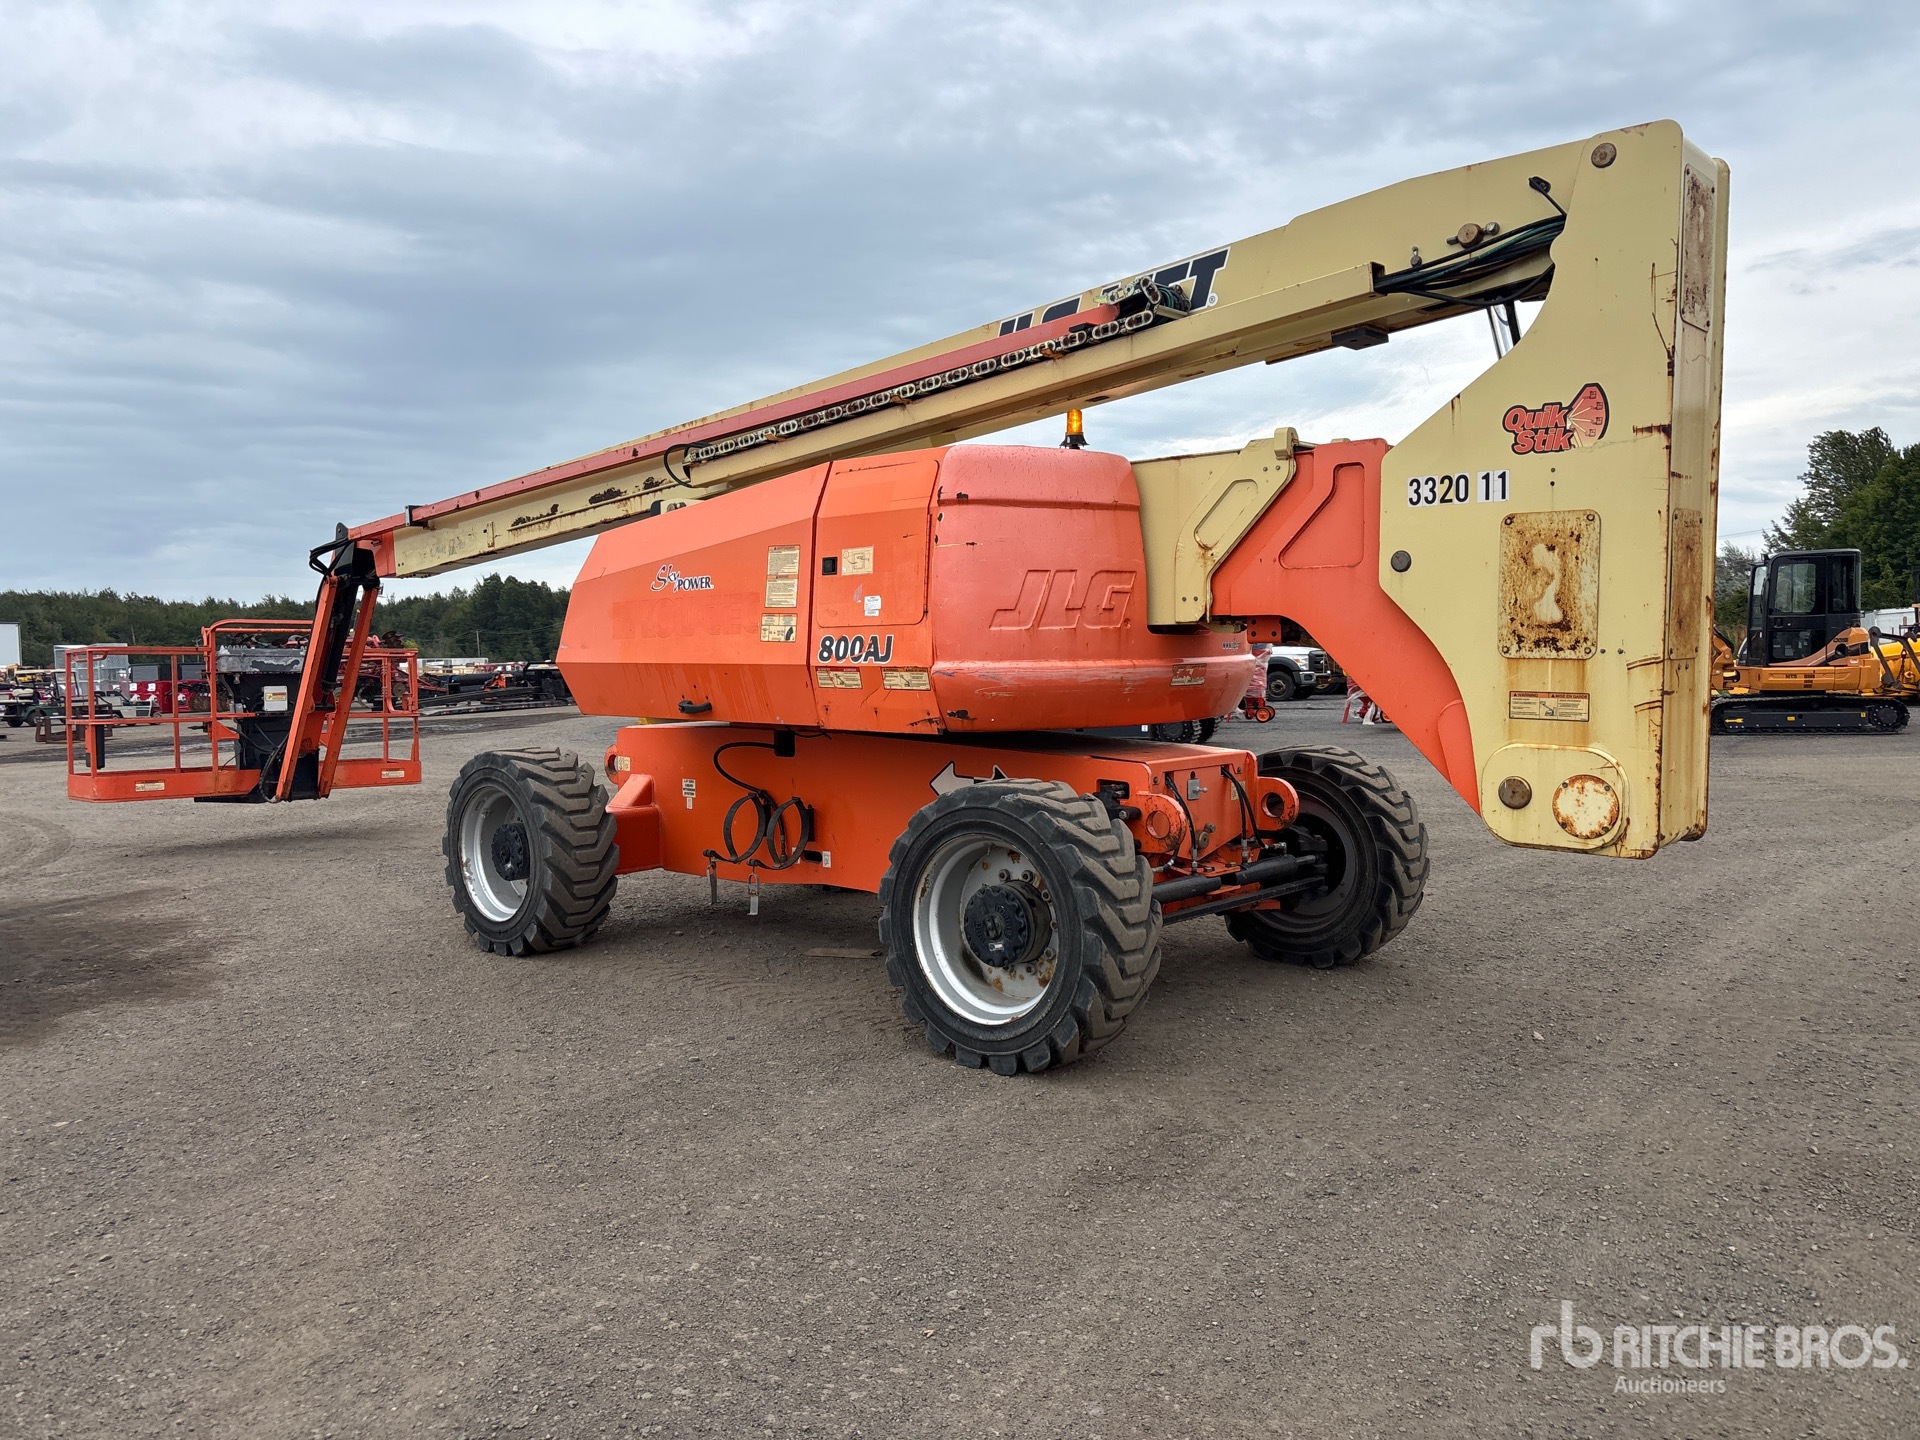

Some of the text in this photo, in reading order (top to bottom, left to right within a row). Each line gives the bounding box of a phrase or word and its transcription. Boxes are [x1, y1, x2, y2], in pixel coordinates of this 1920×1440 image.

[1504, 404, 1568, 433] Quik
[1513, 428, 1574, 453] Stik
[1408, 470, 1507, 506] 3320 11
[650, 564, 712, 593] Sky POWER
[989, 569, 1138, 630] JLG
[818, 634, 895, 664] 800AJ
